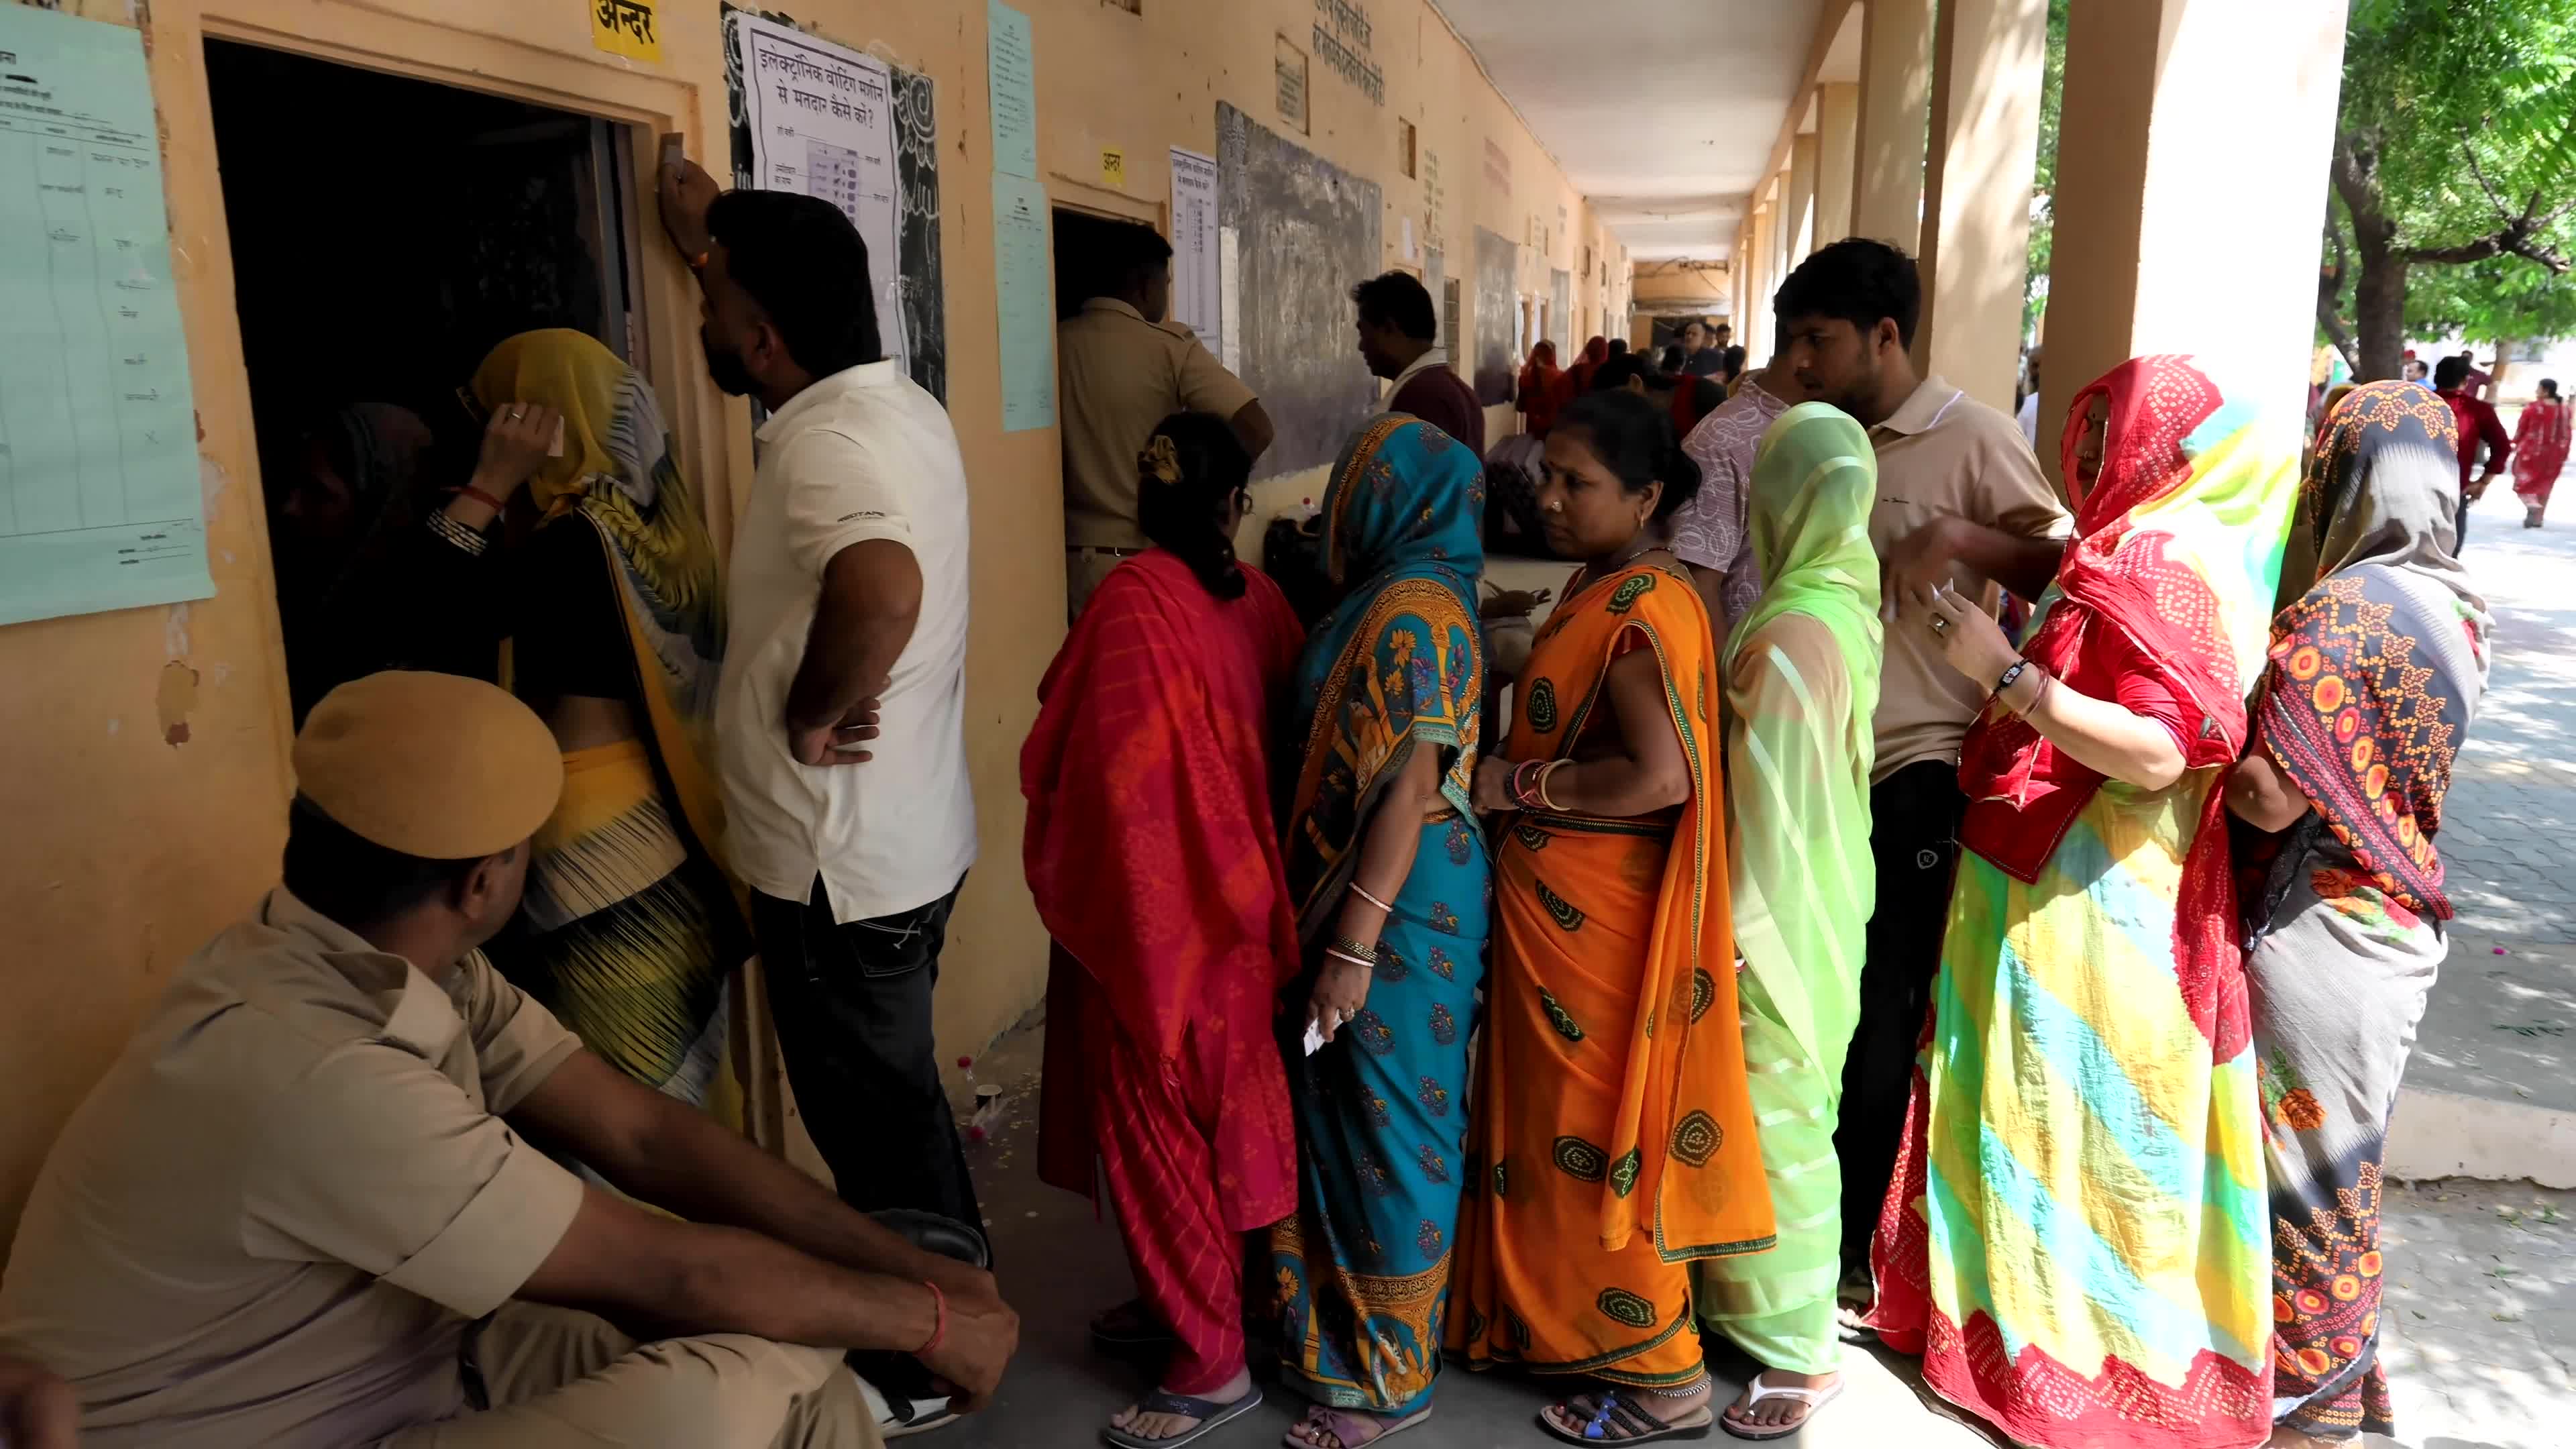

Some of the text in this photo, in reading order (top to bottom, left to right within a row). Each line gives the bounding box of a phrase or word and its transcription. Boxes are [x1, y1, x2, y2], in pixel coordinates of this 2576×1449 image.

[776, 78, 788, 104] से
[792, 89, 827, 115] मतदान
[830, 93, 851, 121] कैसे
[824, 64, 856, 94] वोटिंग
[858, 79, 883, 102] मशीन
